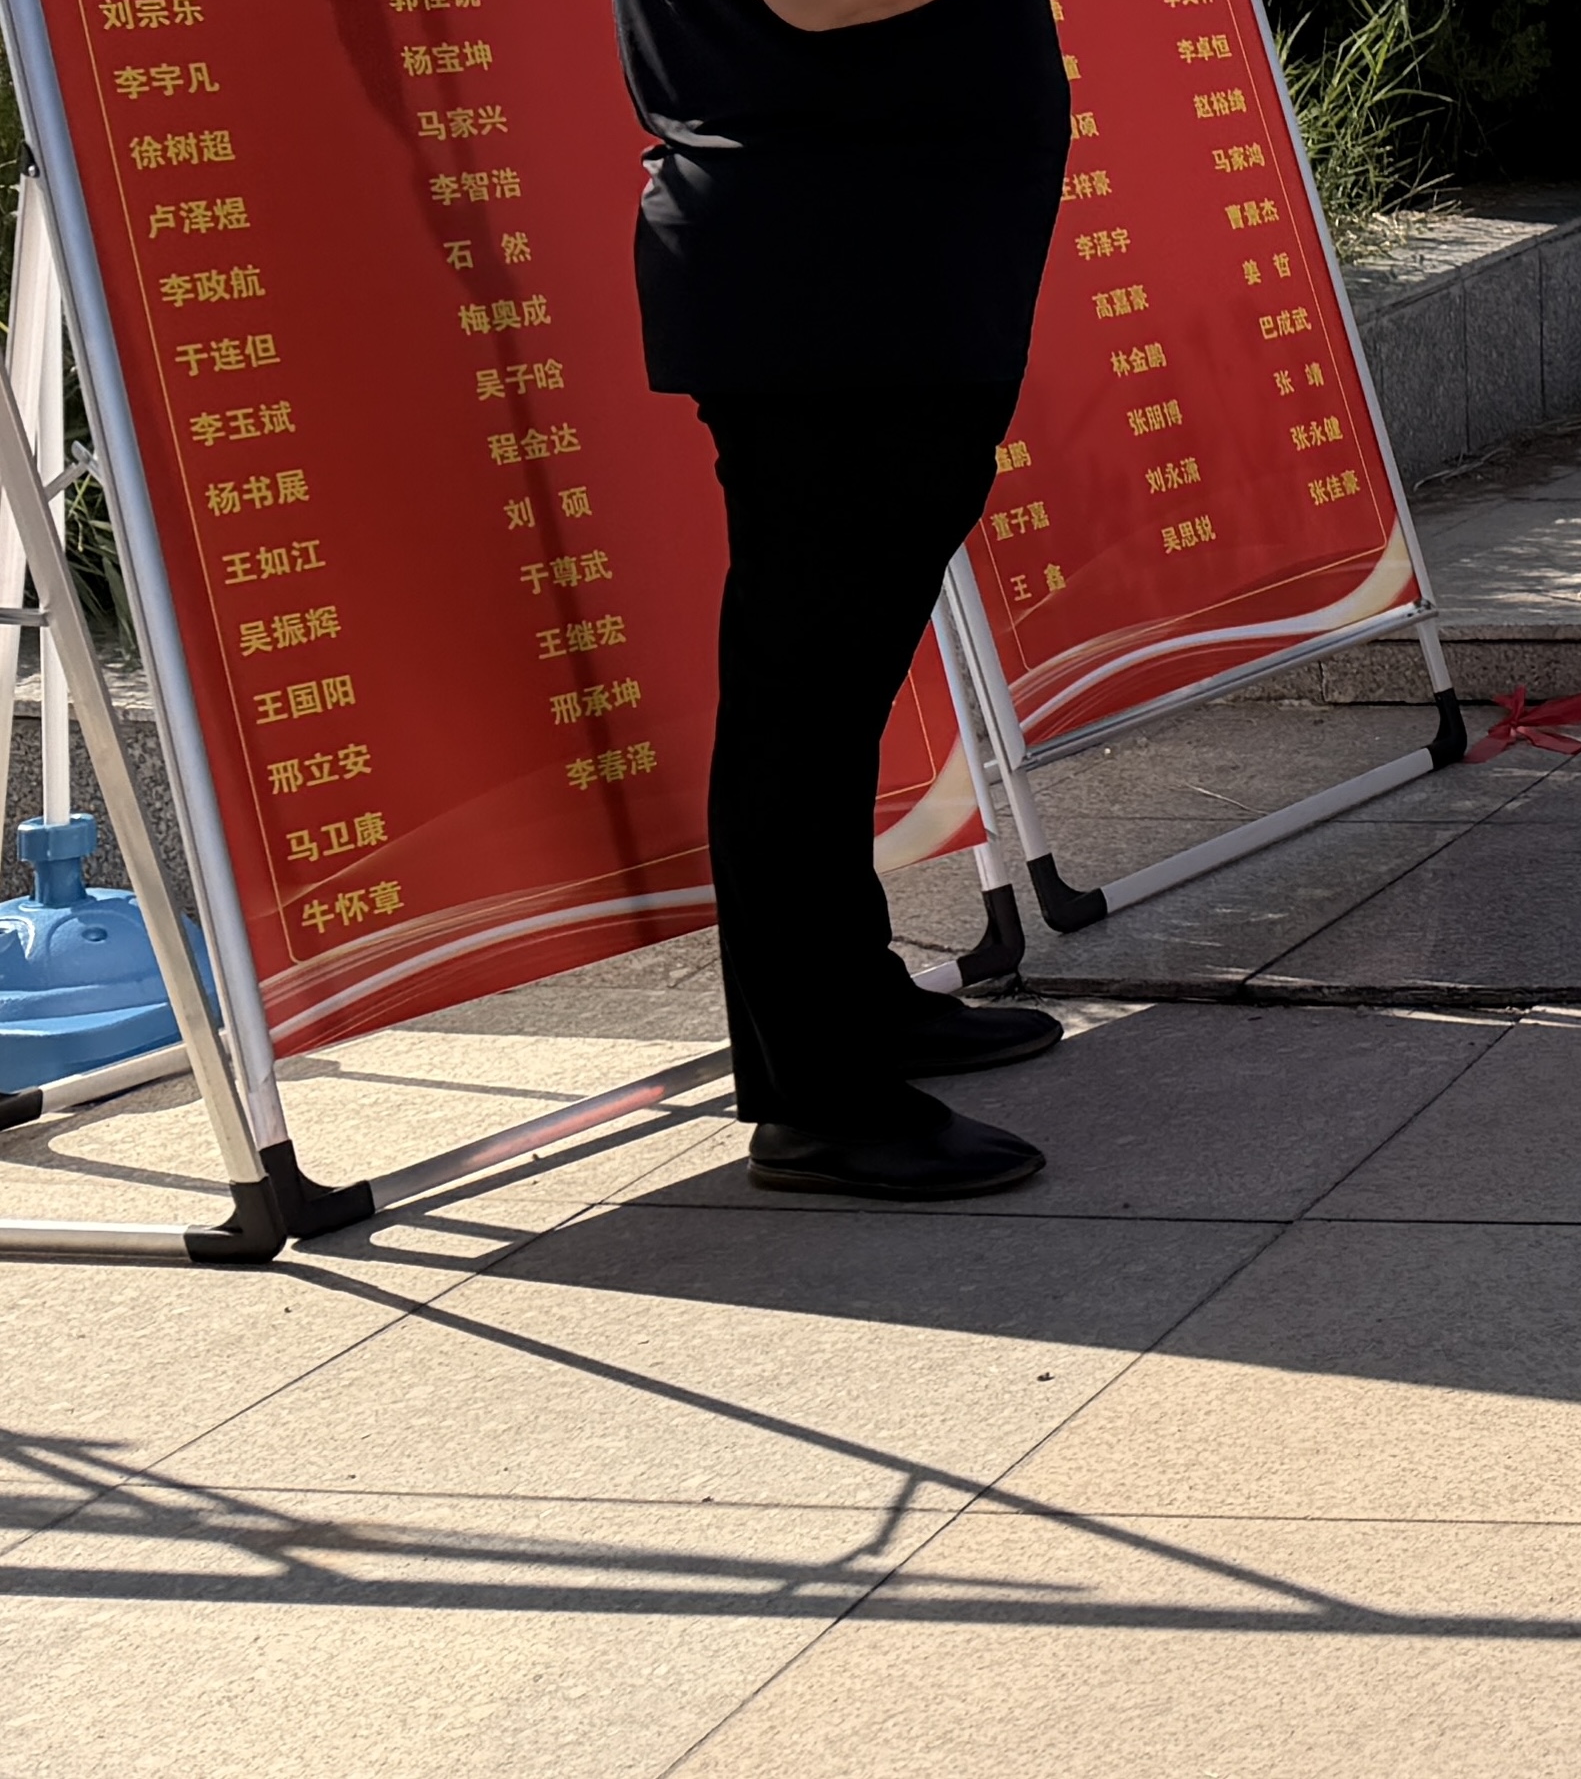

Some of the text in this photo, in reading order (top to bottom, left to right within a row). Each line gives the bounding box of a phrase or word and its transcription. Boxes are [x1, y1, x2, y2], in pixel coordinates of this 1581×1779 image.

[402, 41, 493, 77] 杨宝坤
[1177, 34, 1232, 62] 李卓恒
[114, 62, 220, 100] 李宇凡
[419, 107, 505, 141] 马家兴
[130, 130, 236, 170] 徐树超
[432, 168, 521, 205] 李智浩
[149, 196, 250, 239] 卢泽煜
[1076, 228, 1129, 260] 李泽宇
[160, 265, 266, 308] 李政航
[458, 295, 551, 334] 梅奥成
[1259, 307, 1312, 340] 巴成武
[176, 333, 280, 377] 于连但
[476, 359, 564, 400] 吴子晗
[190, 400, 296, 447] 李玉斌
[1127, 400, 1183, 436] 张朋博
[1290, 416, 1344, 450] 张永健
[488, 424, 581, 464] 程金达
[206, 469, 310, 517] 杨书展
[990, 501, 1050, 541] 董子嘉
[1162, 517, 1216, 551] 吴思锐
[223, 540, 326, 585] 王如江
[520, 549, 613, 595] 于尊武
[239, 605, 341, 657] 吴振辉
[537, 615, 627, 658] 王继宏
[254, 674, 356, 725] 王国阳
[550, 678, 641, 723] 邢承坤
[267, 743, 372, 795] 邢立安
[566, 742, 657, 790] 李春泽
[287, 812, 388, 862] 马卫康
[301, 881, 404, 934] 牛怀章
